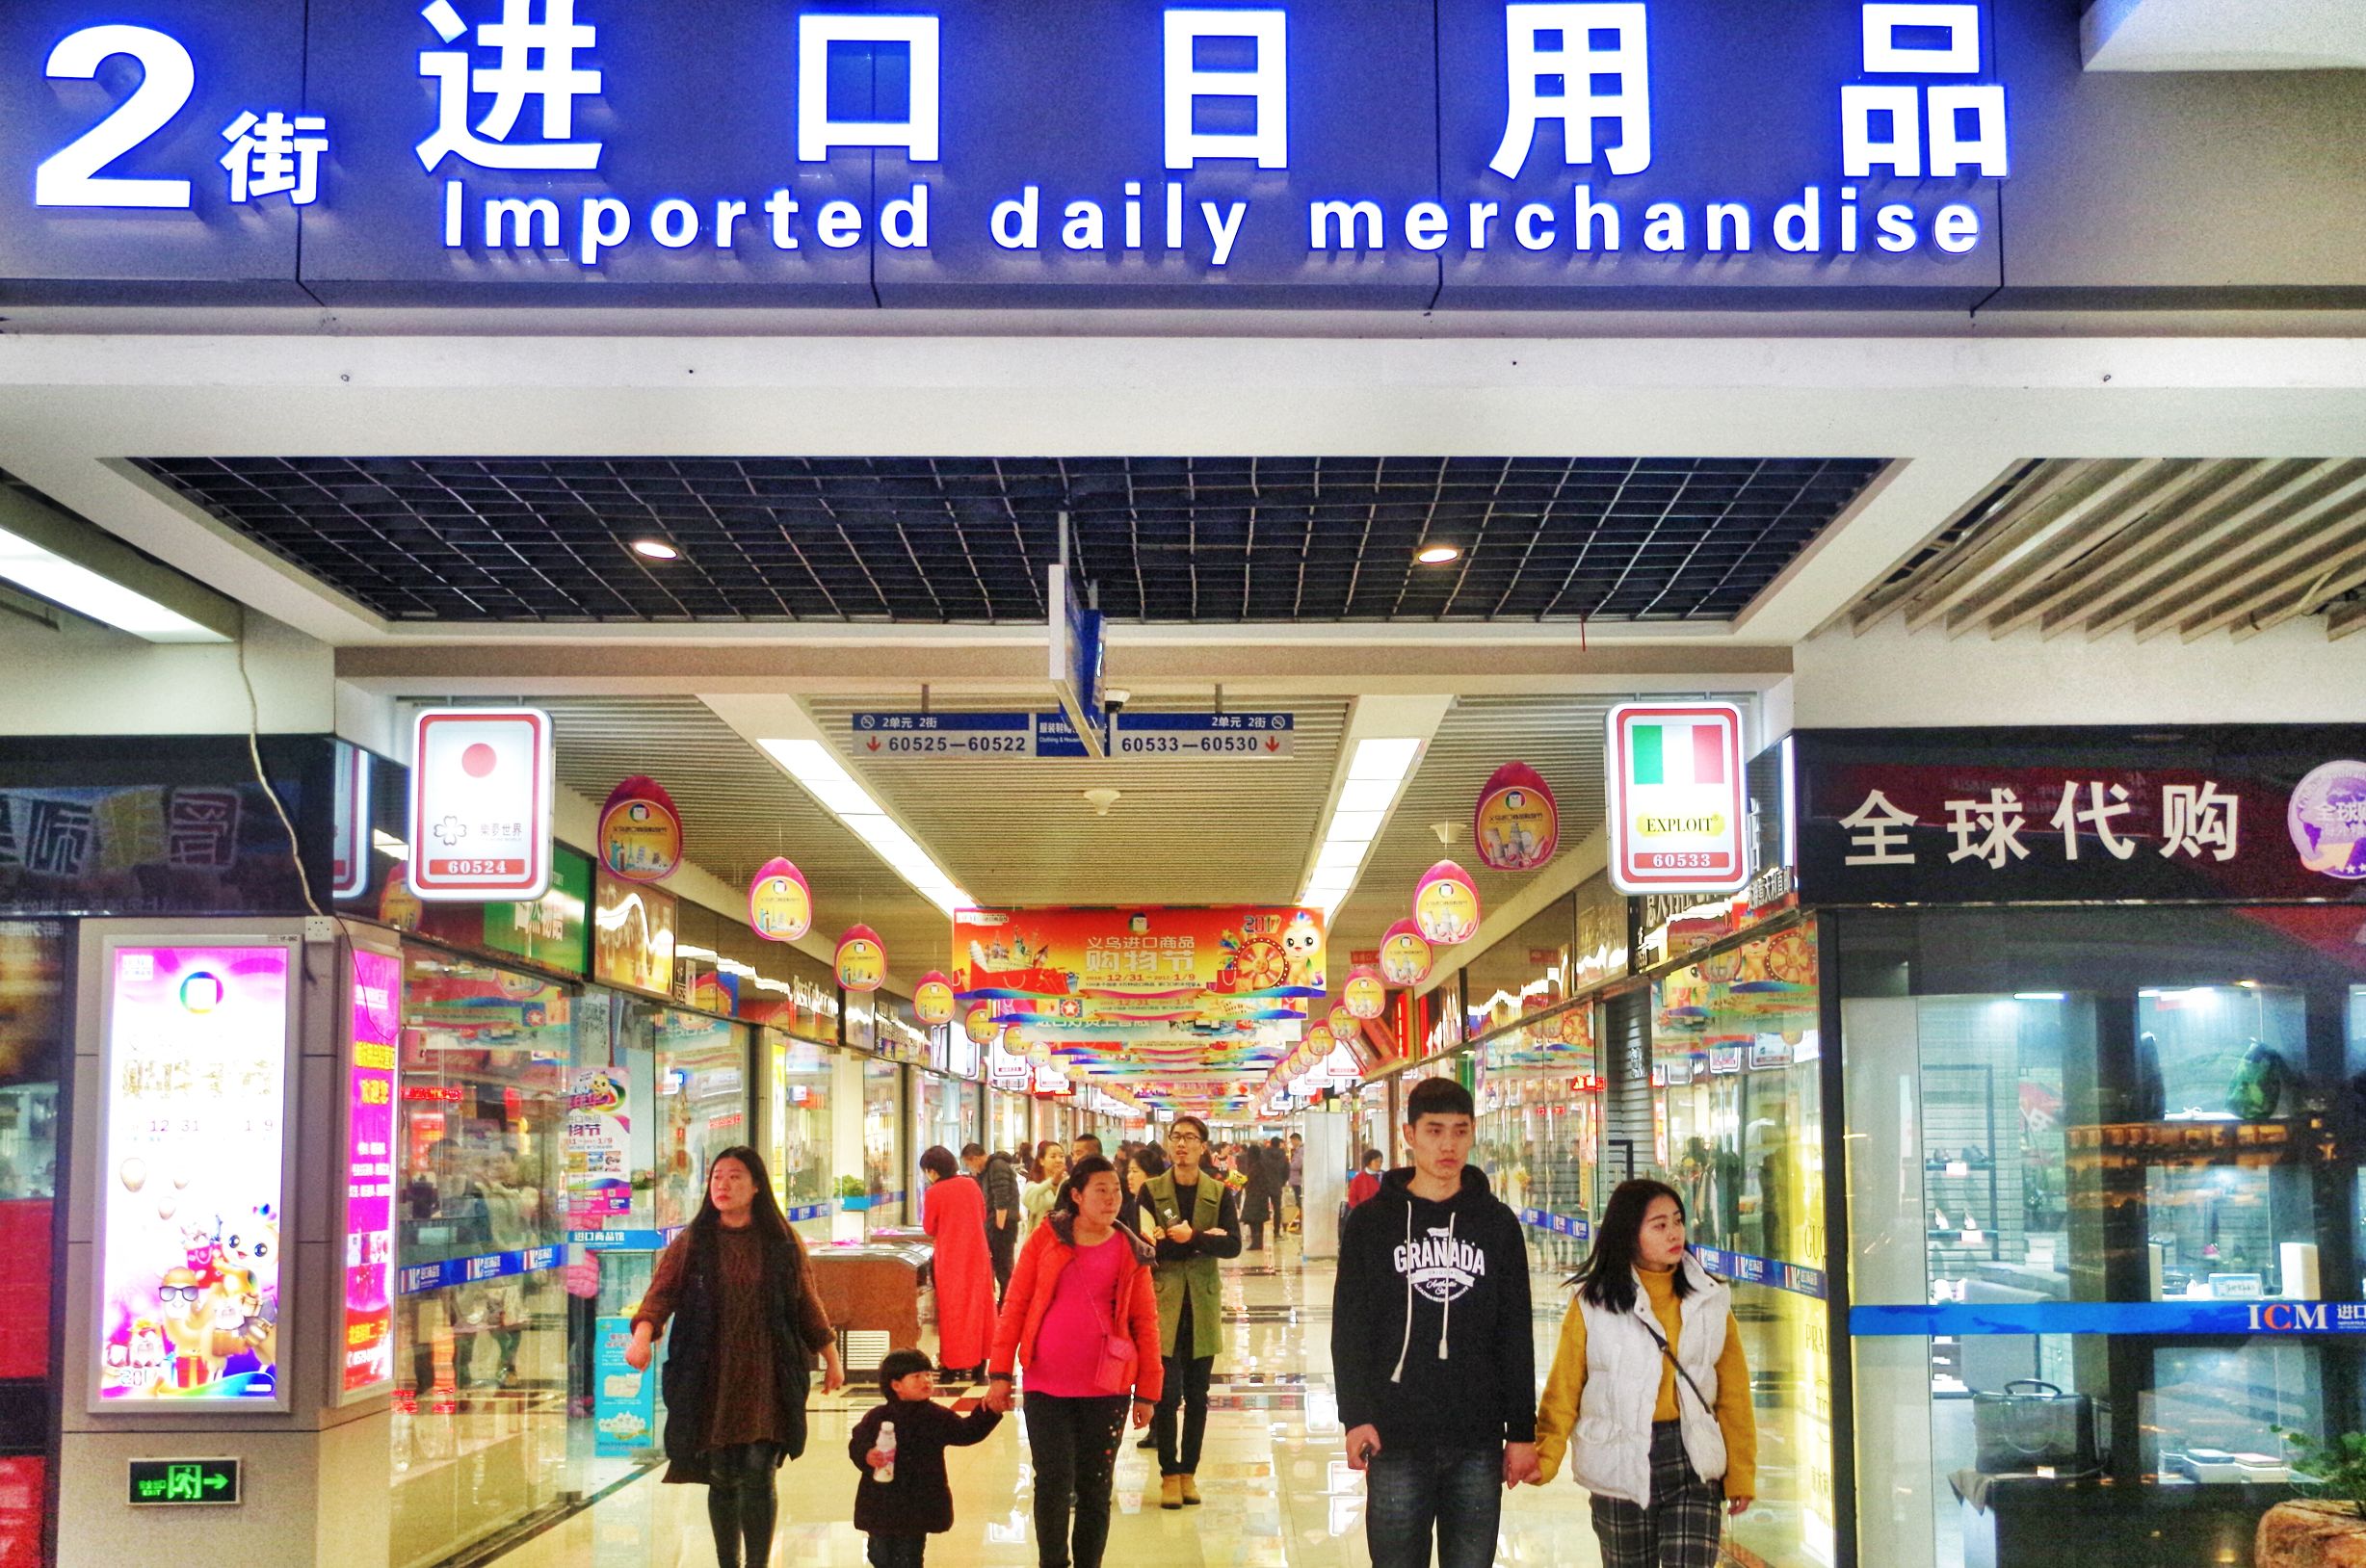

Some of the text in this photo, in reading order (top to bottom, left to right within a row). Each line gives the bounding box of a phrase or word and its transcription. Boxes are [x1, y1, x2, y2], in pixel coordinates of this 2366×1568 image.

[416, 0, 2009, 180] 进口日用品
[444, 180, 1980, 266] Imported daily merchandise
[882, 717, 937, 729] 2单元 2街
[1212, 716, 1266, 729] 2单元 2街
[1646, 817, 1713, 832] EXPLOIT
[1838, 779, 2240, 871] 全球代购
[448, 860, 507, 875] 60524
[1653, 853, 1712, 867] 60533
[1087, 935, 1195, 950] 义乌进口商品
[1086, 950, 1196, 973] 购物节
[1394, 1240, 1485, 1277] GRANADA
[2247, 1304, 2328, 1330] ICM
